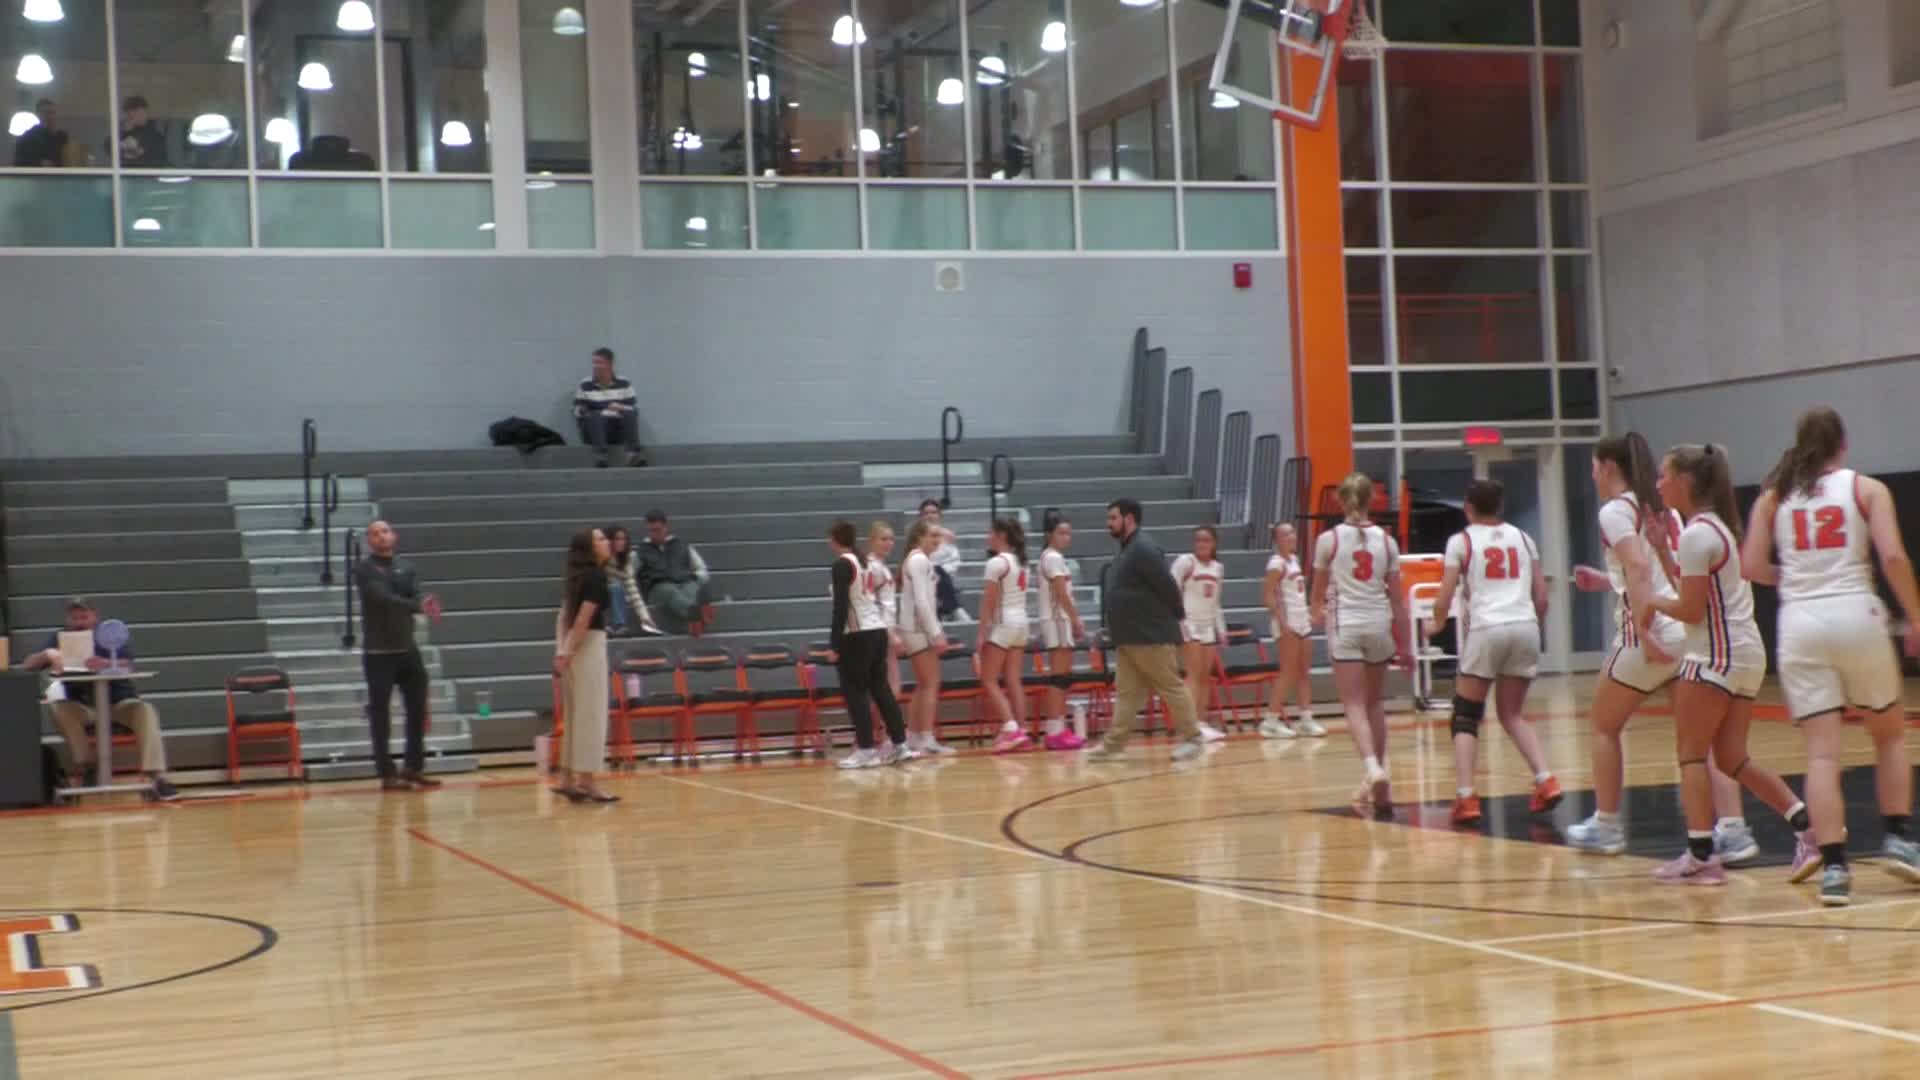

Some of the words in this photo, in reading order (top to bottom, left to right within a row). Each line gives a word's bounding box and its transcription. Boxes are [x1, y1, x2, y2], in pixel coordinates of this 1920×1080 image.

[1792, 505, 1846, 550] 12
[1352, 550, 1373, 581] 3
[1483, 547, 1520, 579] 21
